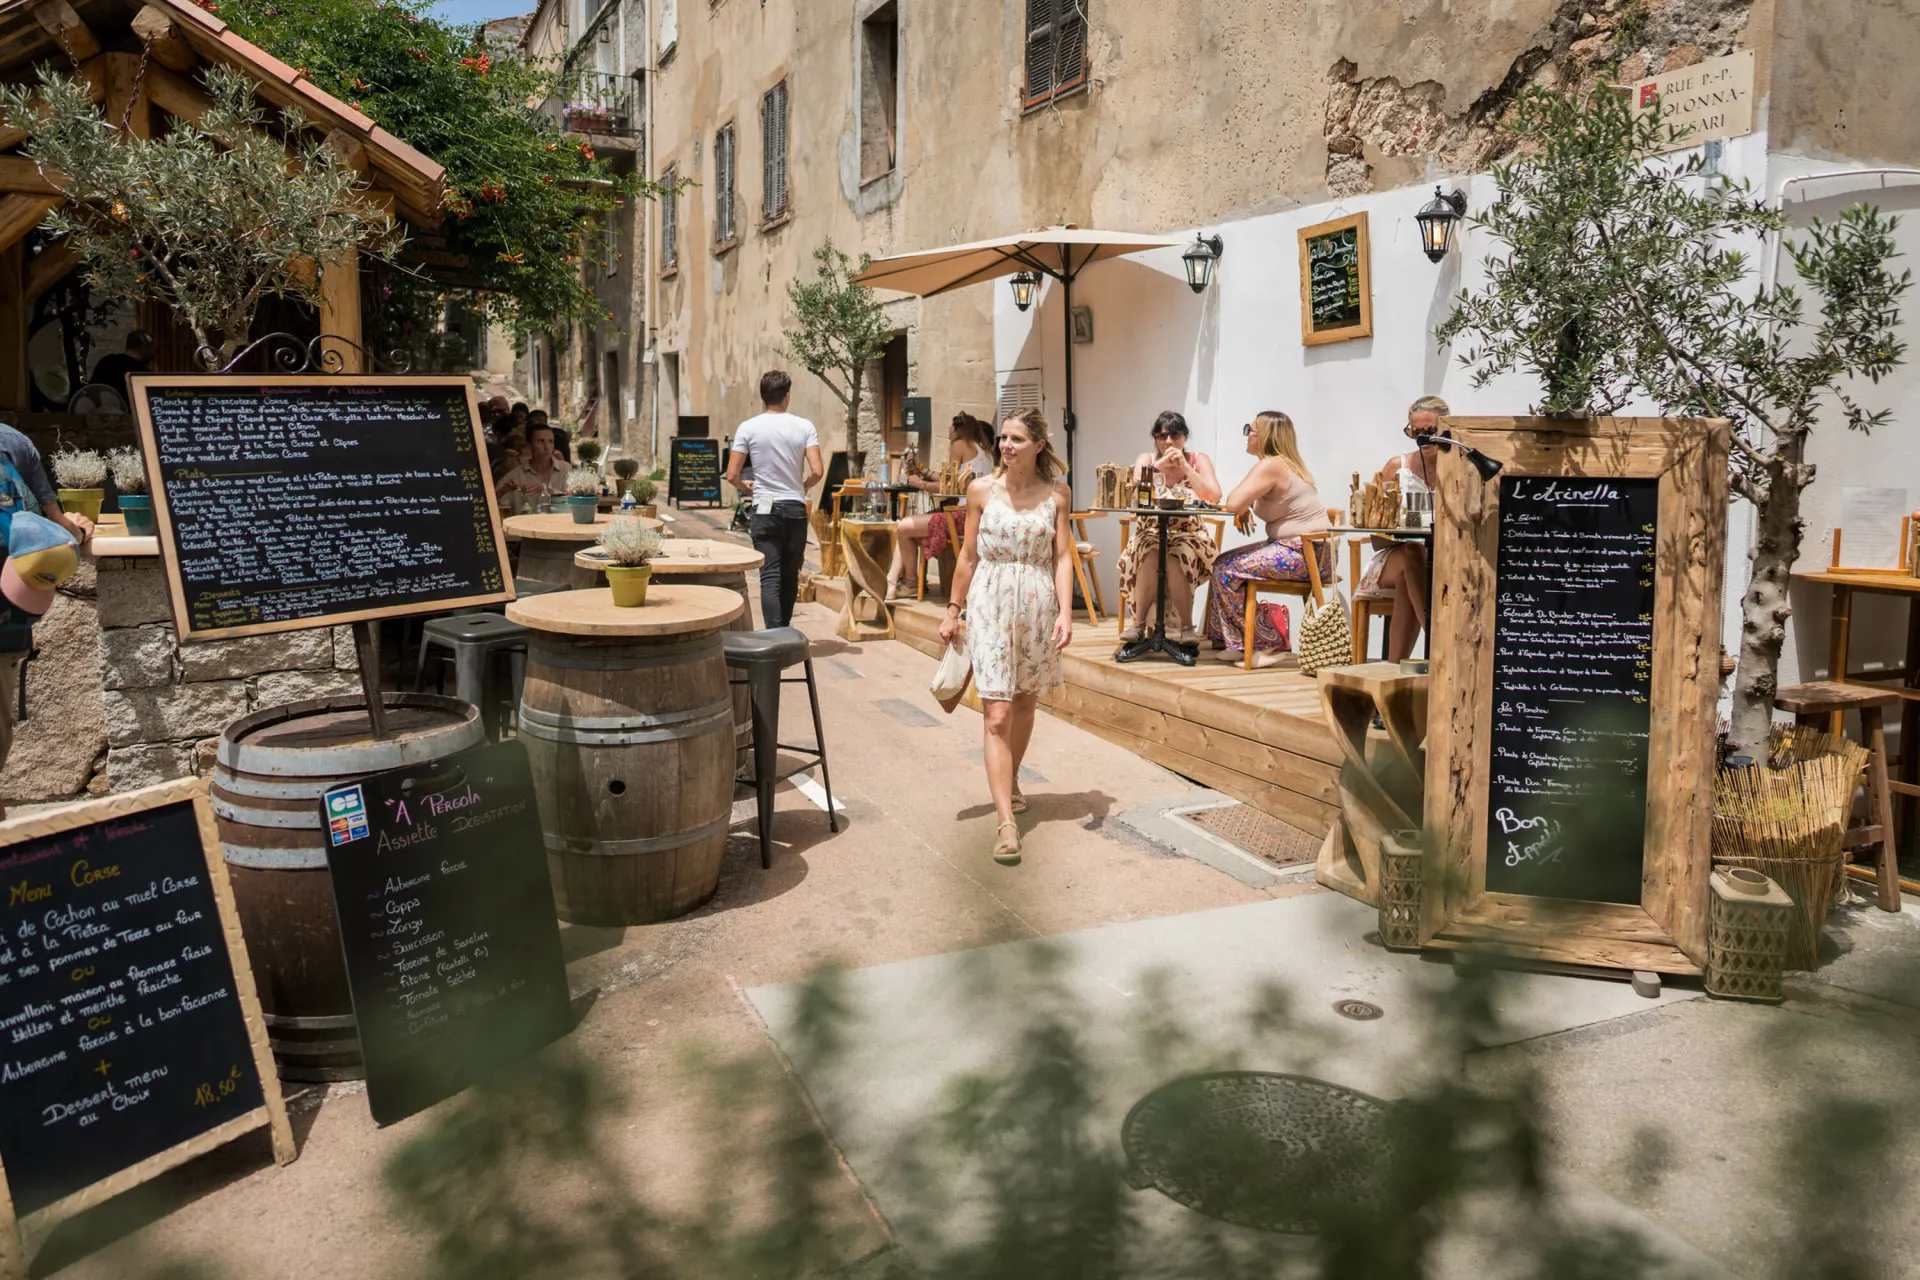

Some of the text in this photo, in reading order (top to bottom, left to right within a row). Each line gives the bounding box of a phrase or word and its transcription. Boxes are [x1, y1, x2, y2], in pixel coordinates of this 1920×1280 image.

[1666, 78, 1693, 94] RUE
[1662, 88, 1745, 117] OLONNA-
[1496, 807, 1548, 834] Bon
[377, 823, 438, 855] Assiette
[9, 879, 53, 906] Menu
[386, 898, 420, 915] Coppa
[18, 920, 37, 938] de
[44, 904, 96, 930] Cochon
[102, 900, 120, 913] au
[387, 918, 423, 935] Lonzu
[1, 950, 16, 965] et
[22, 943, 33, 958] à
[42, 936, 60, 950] la
[18, 964, 40, 975] ses
[48, 946, 99, 971] pommes
[103, 936, 117, 950] de
[156, 922, 173, 932] au
[436, 946, 447, 957] de
[0, 945, 212, 1030] annelloni maison au fromage frais
[60, 1010, 74, 1025] et
[79, 993, 126, 1017] menthe
[137, 973, 182, 996] fraiche
[400, 985, 439, 1005] Tomate
[78, 1031, 118, 1051] farcie
[125, 1022, 134, 1035] à
[139, 1013, 153, 1028] la
[42, 1064, 169, 1127] Dessert menu
[79, 1088, 151, 1127] au Choix
